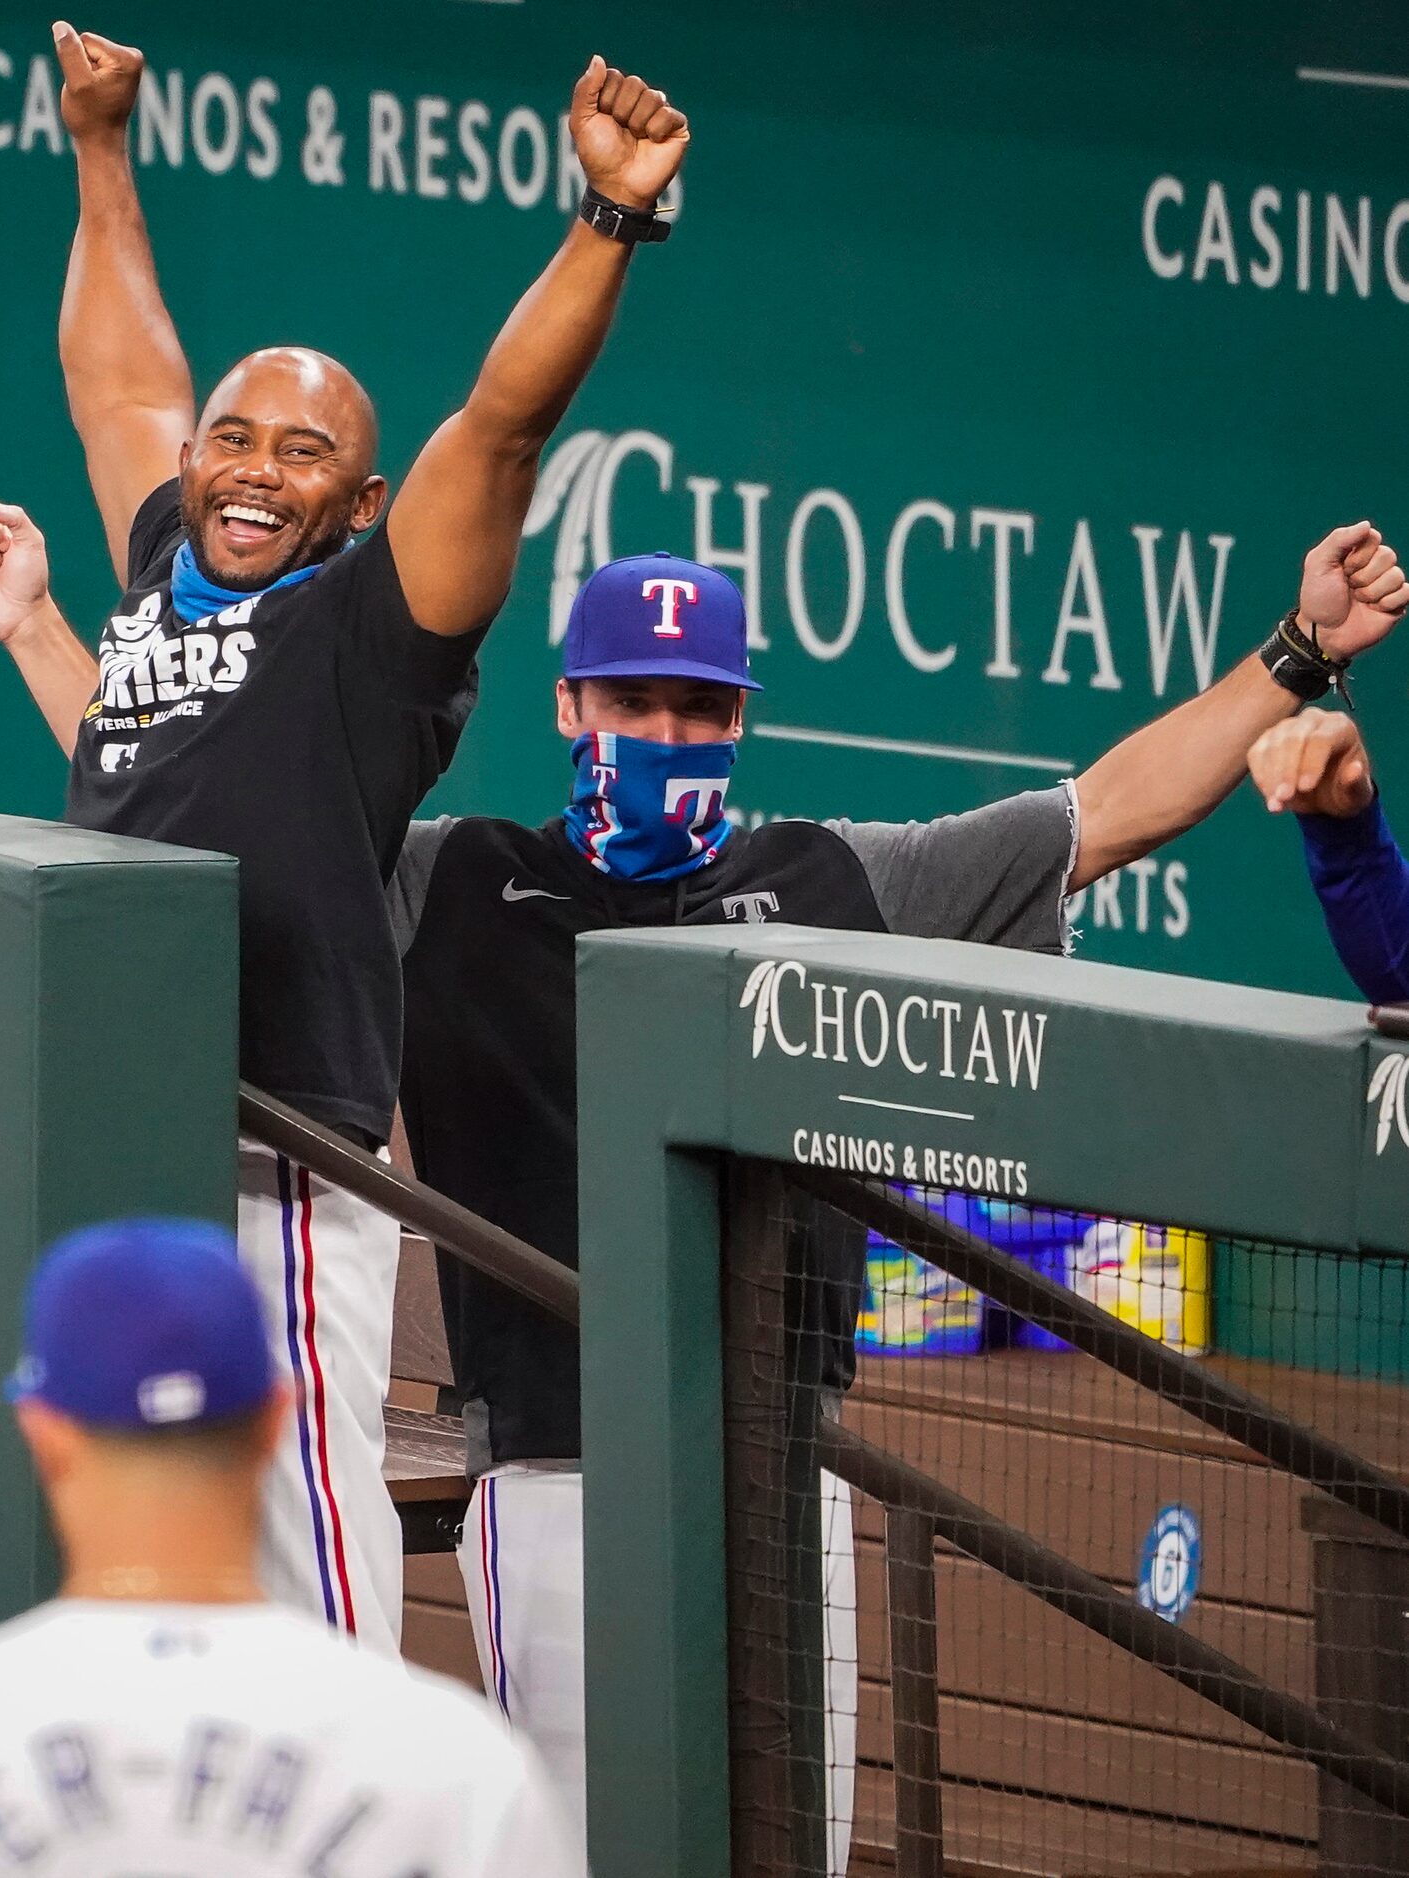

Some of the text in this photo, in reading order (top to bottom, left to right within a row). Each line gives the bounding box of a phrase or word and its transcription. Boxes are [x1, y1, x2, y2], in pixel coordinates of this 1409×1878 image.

[301, 84, 345, 187] &
[641, 578, 698, 639] T
[663, 777, 731, 857] T
[771, 960, 1048, 1092] CHOCTAW
[793, 1127, 1029, 1198] CASINOS & RESORTS
